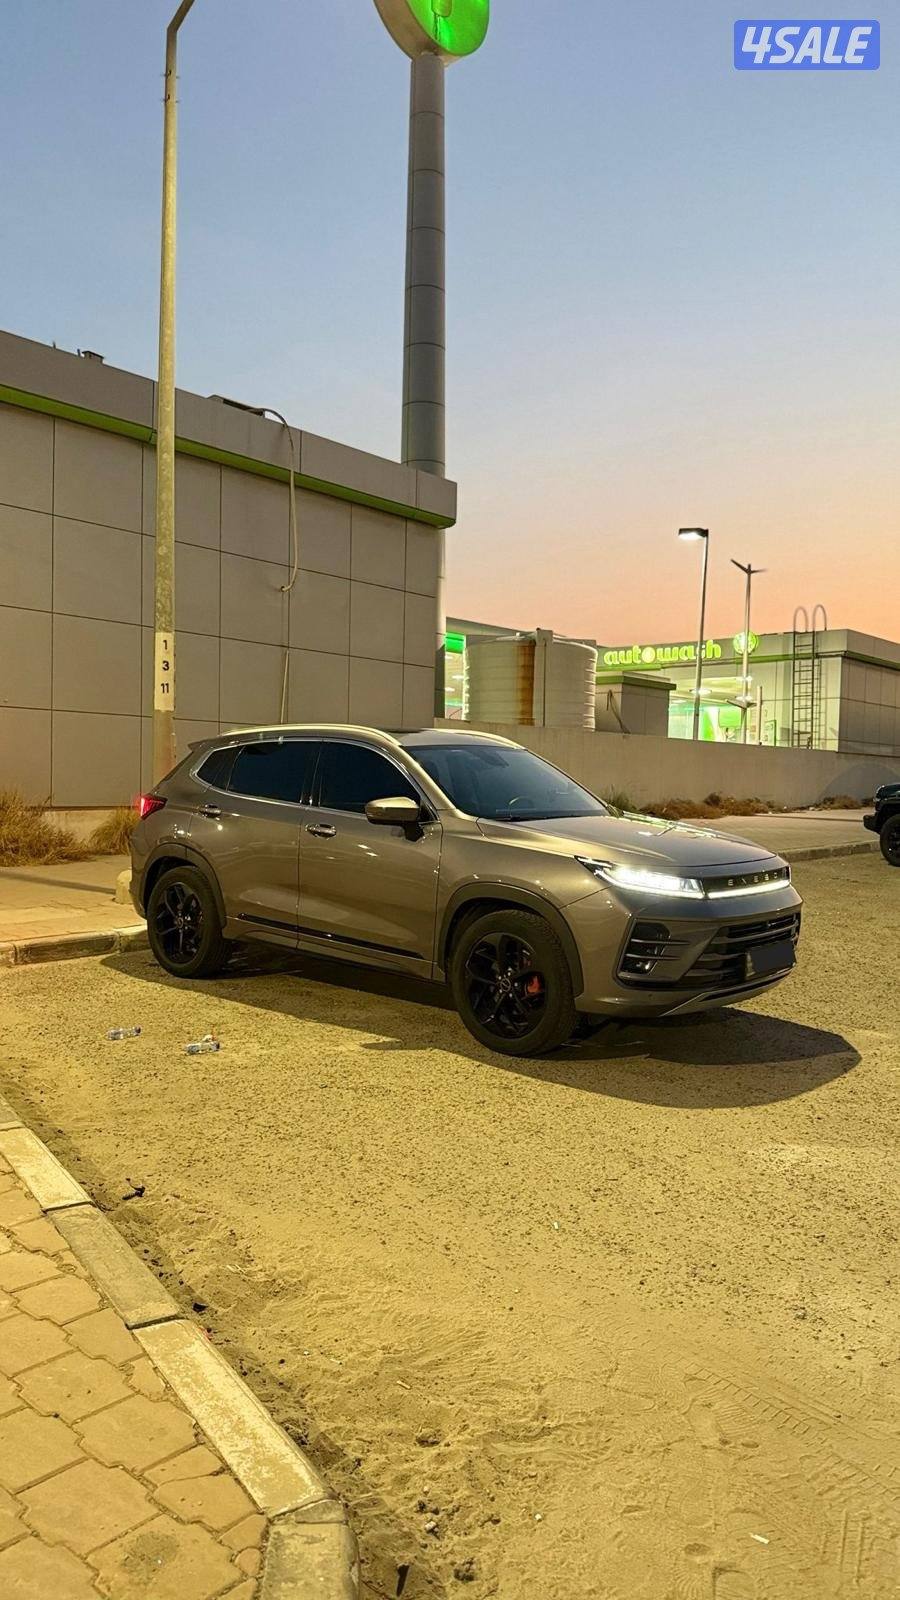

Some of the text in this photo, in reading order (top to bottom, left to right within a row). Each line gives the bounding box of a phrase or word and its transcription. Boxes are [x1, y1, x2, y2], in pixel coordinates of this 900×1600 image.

[162, 639, 168, 650] 1
[162, 660, 170, 671] 3
[160, 682, 170, 694] 11
